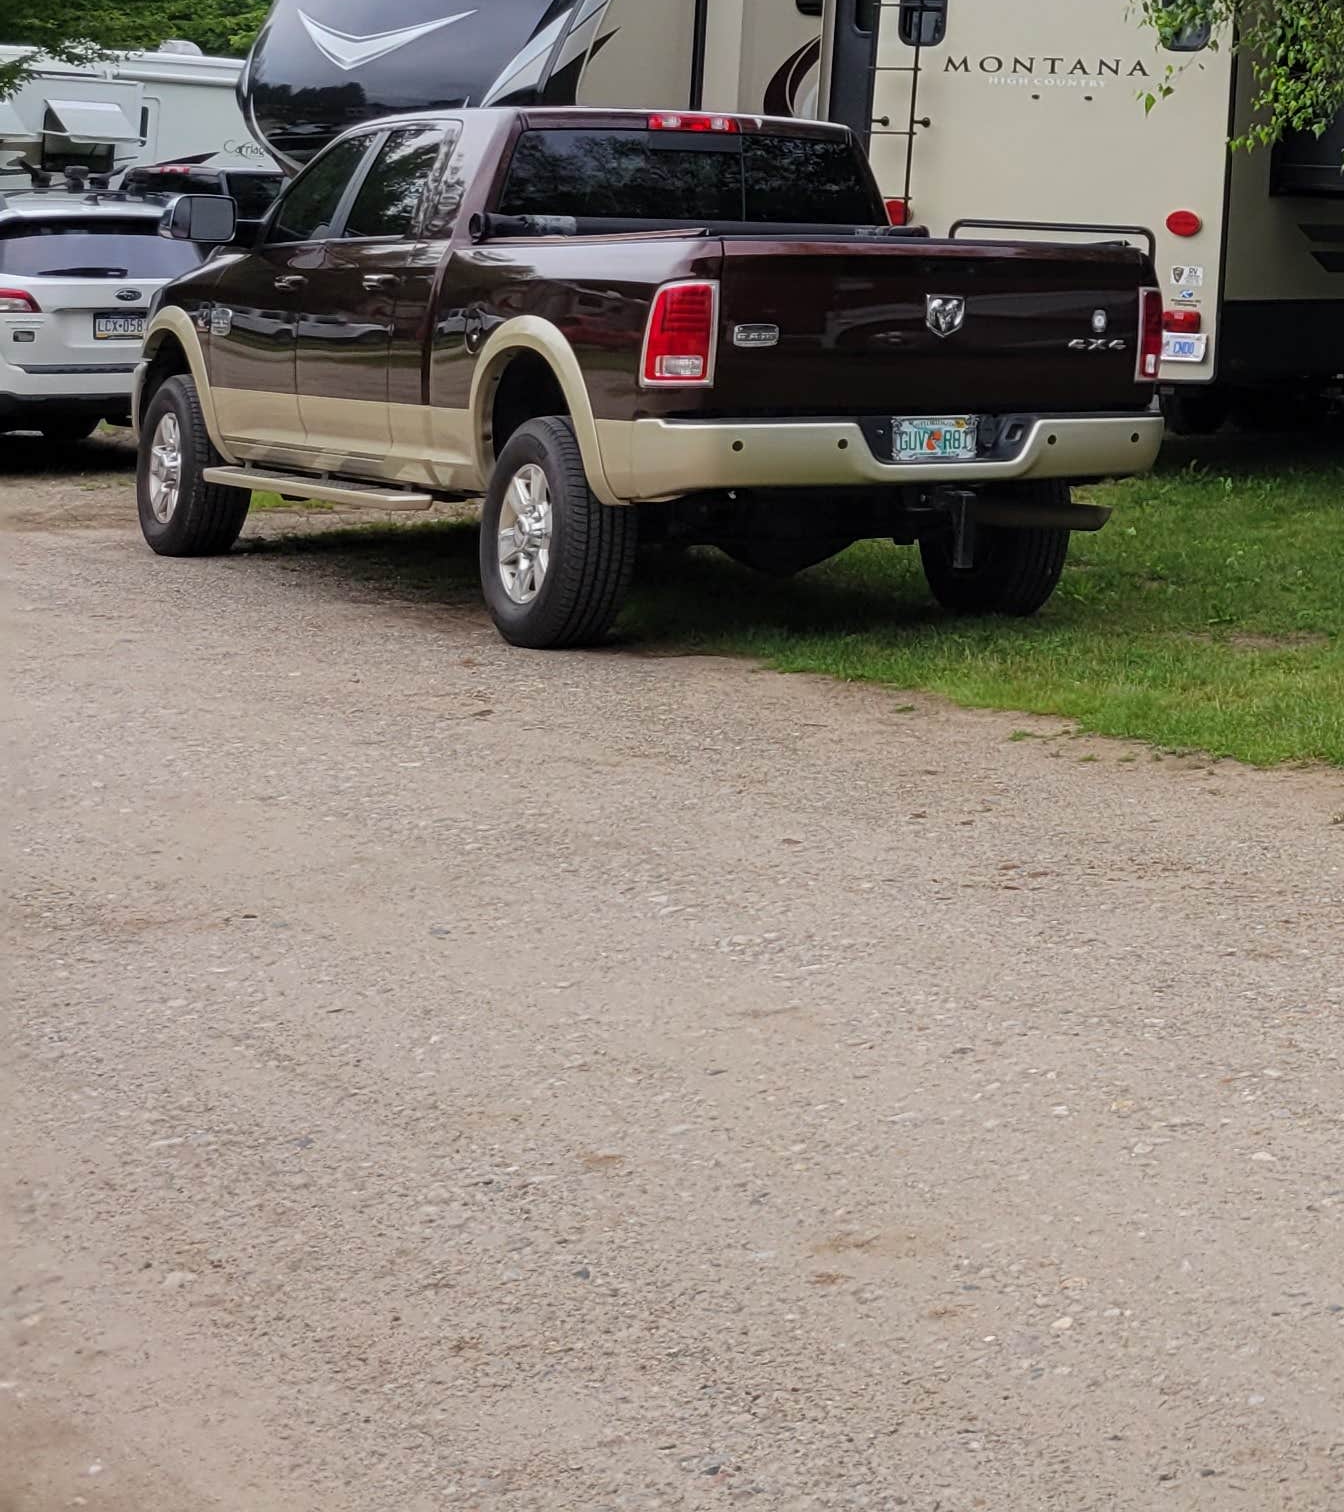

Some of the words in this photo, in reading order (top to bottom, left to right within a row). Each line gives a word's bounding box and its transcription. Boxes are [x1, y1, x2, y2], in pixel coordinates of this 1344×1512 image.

[943, 55, 1150, 77] MONTANA
[988, 76, 1029, 86] HIGH
[1033, 77, 1105, 88] COUNTRY
[900, 430, 928, 450] GUV
